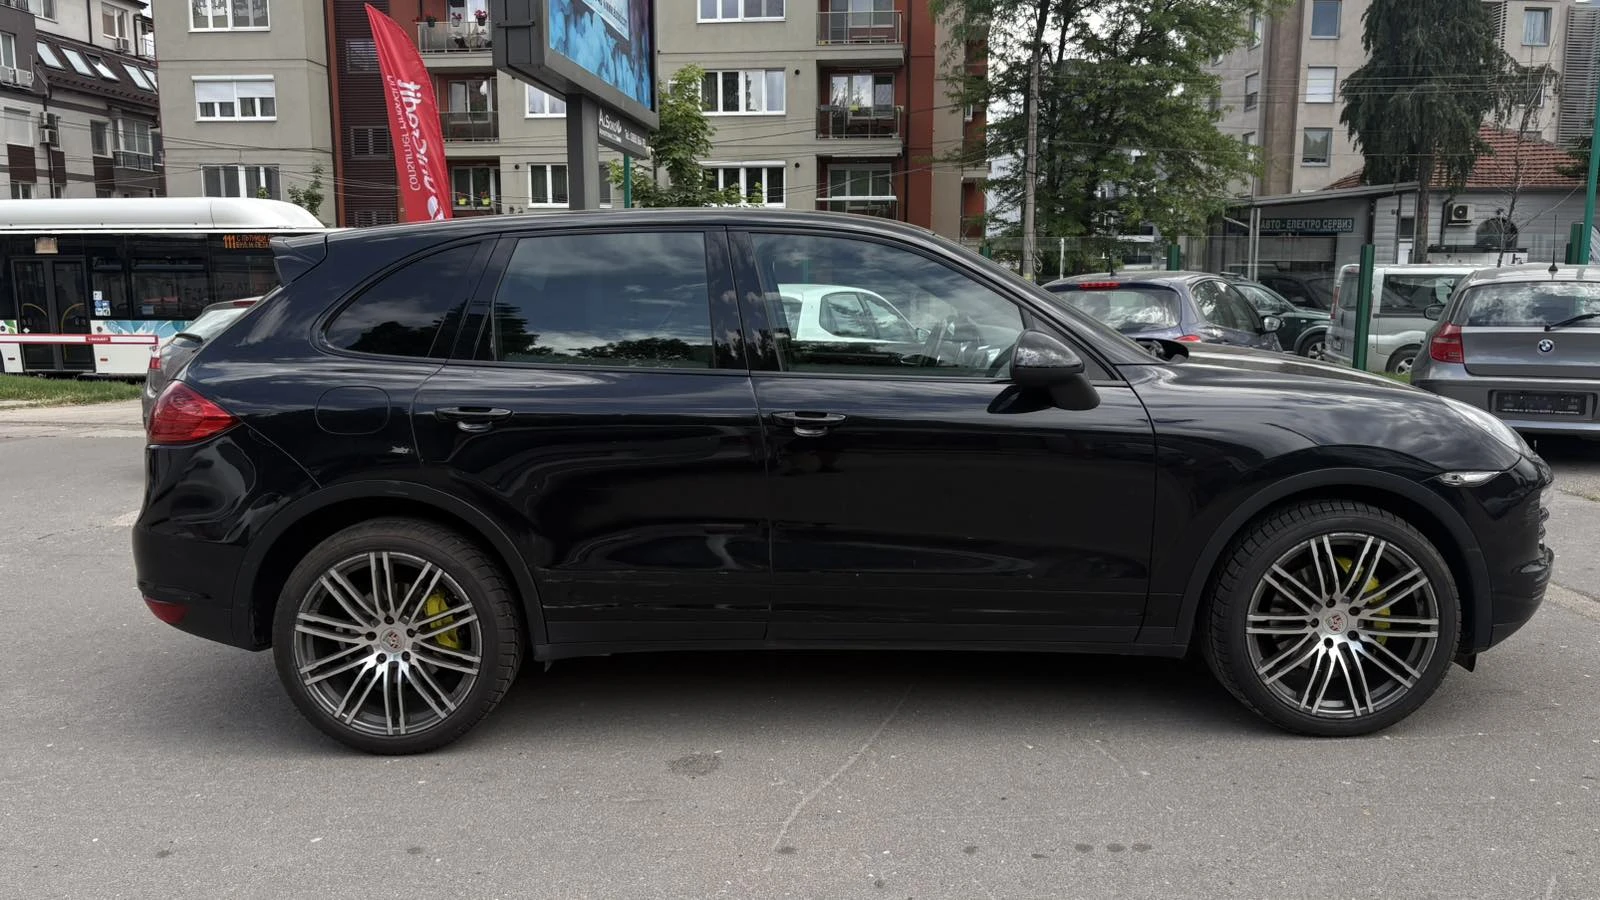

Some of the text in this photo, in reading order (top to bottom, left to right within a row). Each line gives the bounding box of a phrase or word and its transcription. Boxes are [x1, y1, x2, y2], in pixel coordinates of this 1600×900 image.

[1260, 218, 1281, 228] АВТО
[1286, 218, 1321, 229] ЕЛЕКТРО
[1322, 218, 1352, 229] СЕРВИЗ
[223, 234, 236, 249] 111
